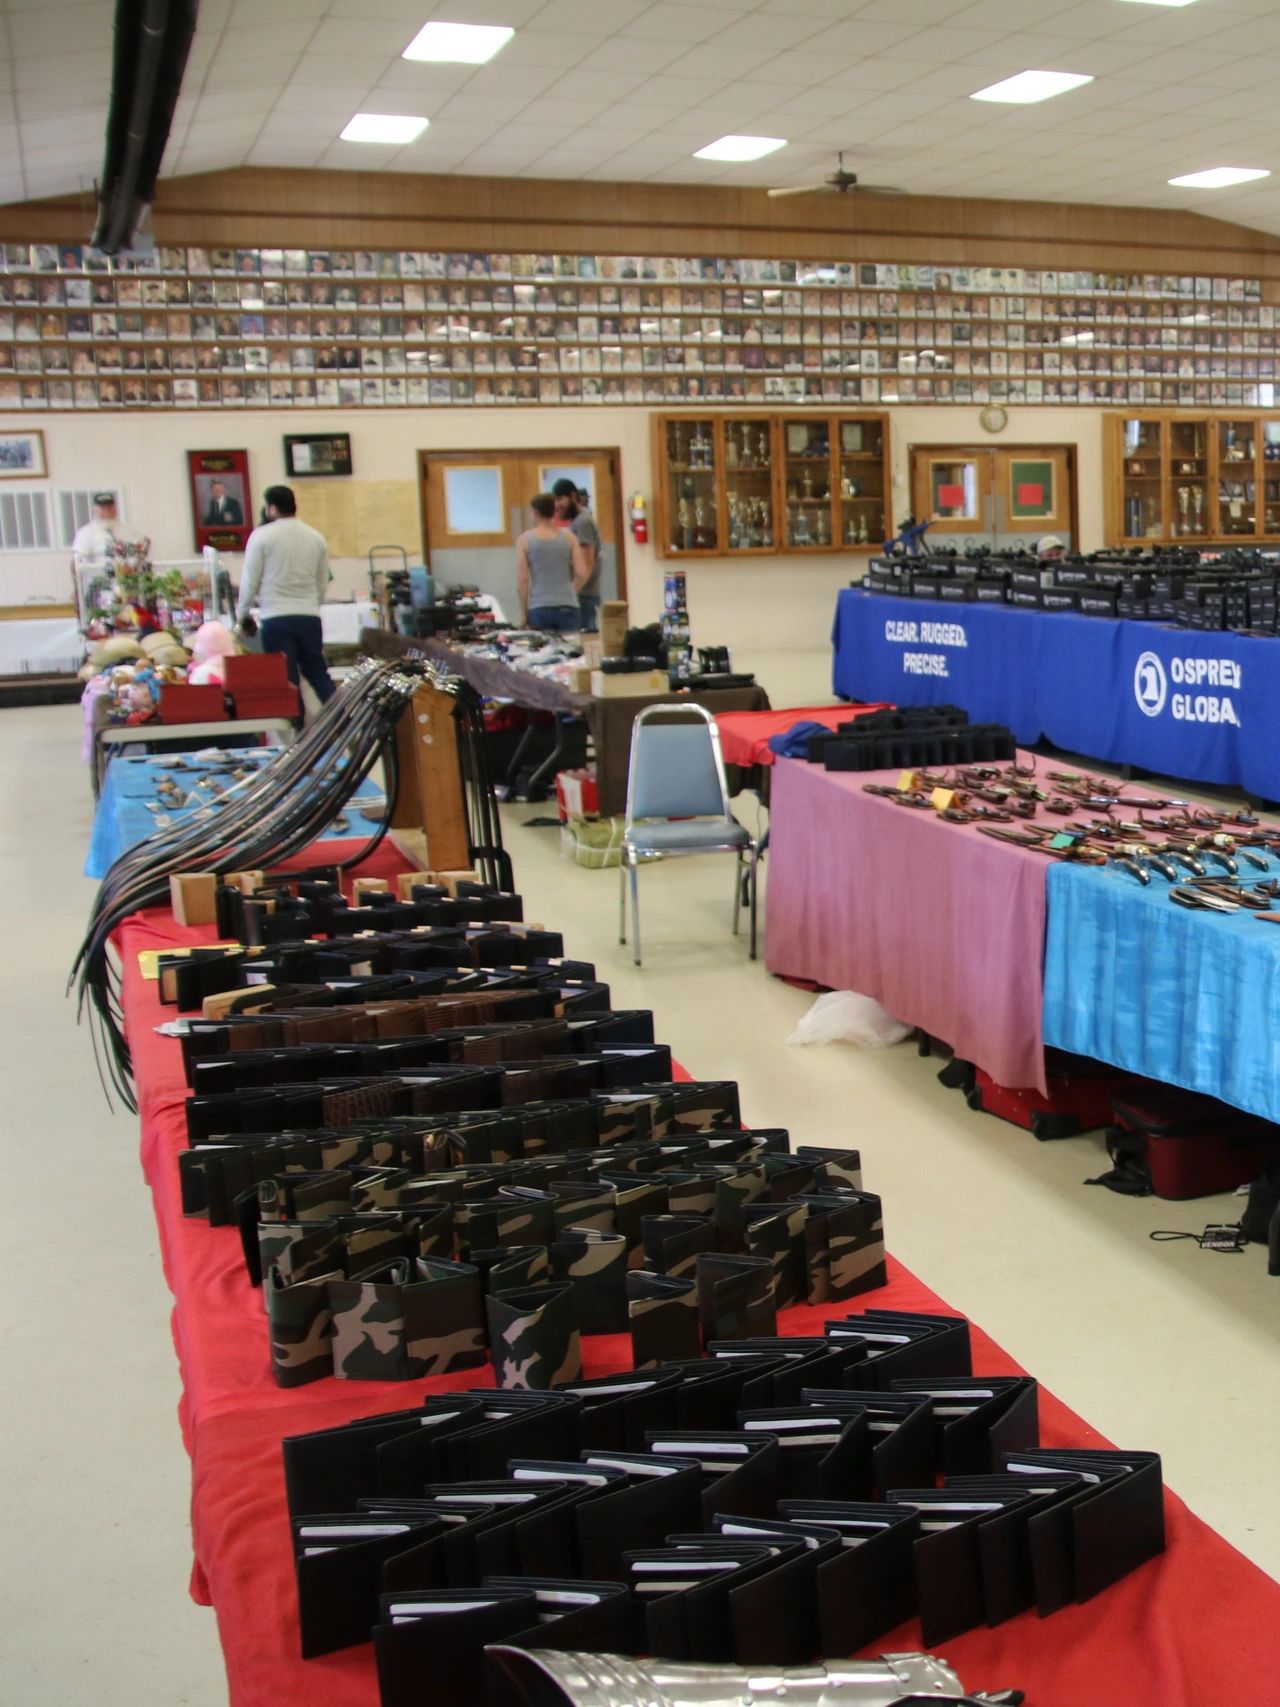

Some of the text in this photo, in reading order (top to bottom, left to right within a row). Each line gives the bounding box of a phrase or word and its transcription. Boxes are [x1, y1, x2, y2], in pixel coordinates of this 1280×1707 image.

[885, 620, 968, 648] CLEAR. RUGGED.
[903, 652, 949, 677] PRECISE.
[1170, 656, 1241, 689] OSPREY
[1171, 693, 1241, 728] GLOBA
